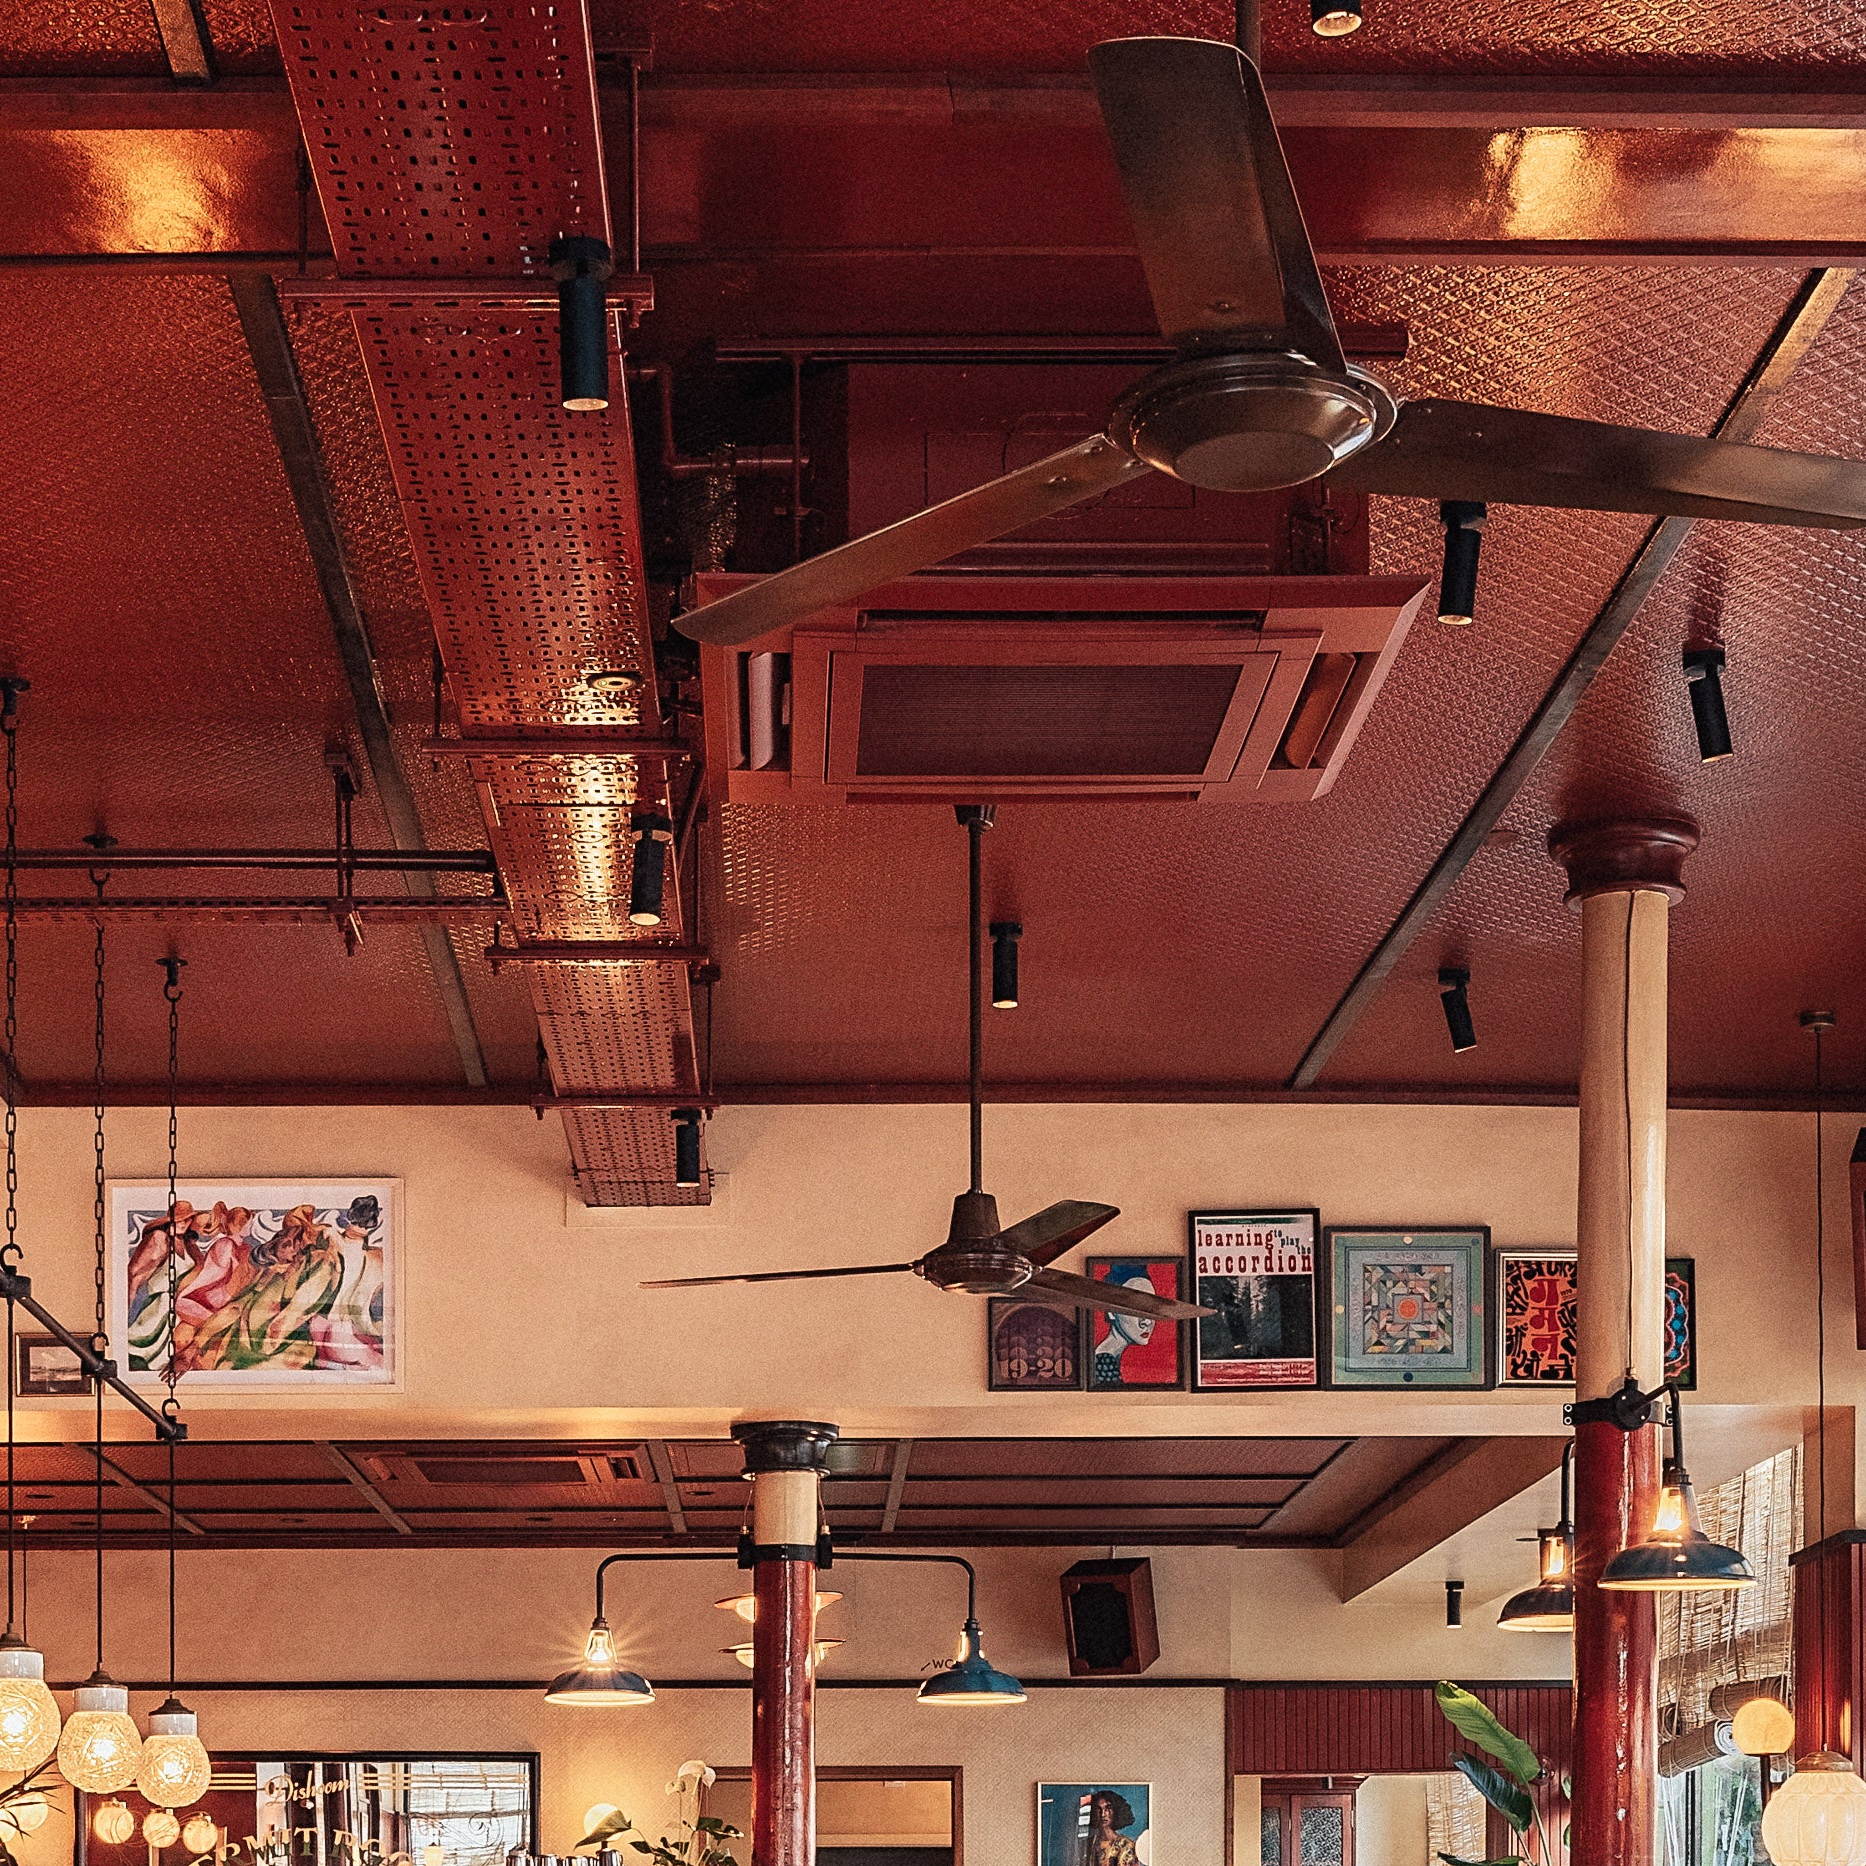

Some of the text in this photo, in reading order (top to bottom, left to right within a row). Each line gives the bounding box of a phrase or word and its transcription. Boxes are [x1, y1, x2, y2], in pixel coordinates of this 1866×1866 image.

[1198, 1229, 1282, 1250] learning to
[1280, 1236, 1301, 1248] play
[1296, 1245, 1311, 1255] the
[1198, 1249, 1312, 1273] accordion
[1000, 1358, 1074, 1379] 19-20
[264, 1770, 350, 1807] Dishoom
